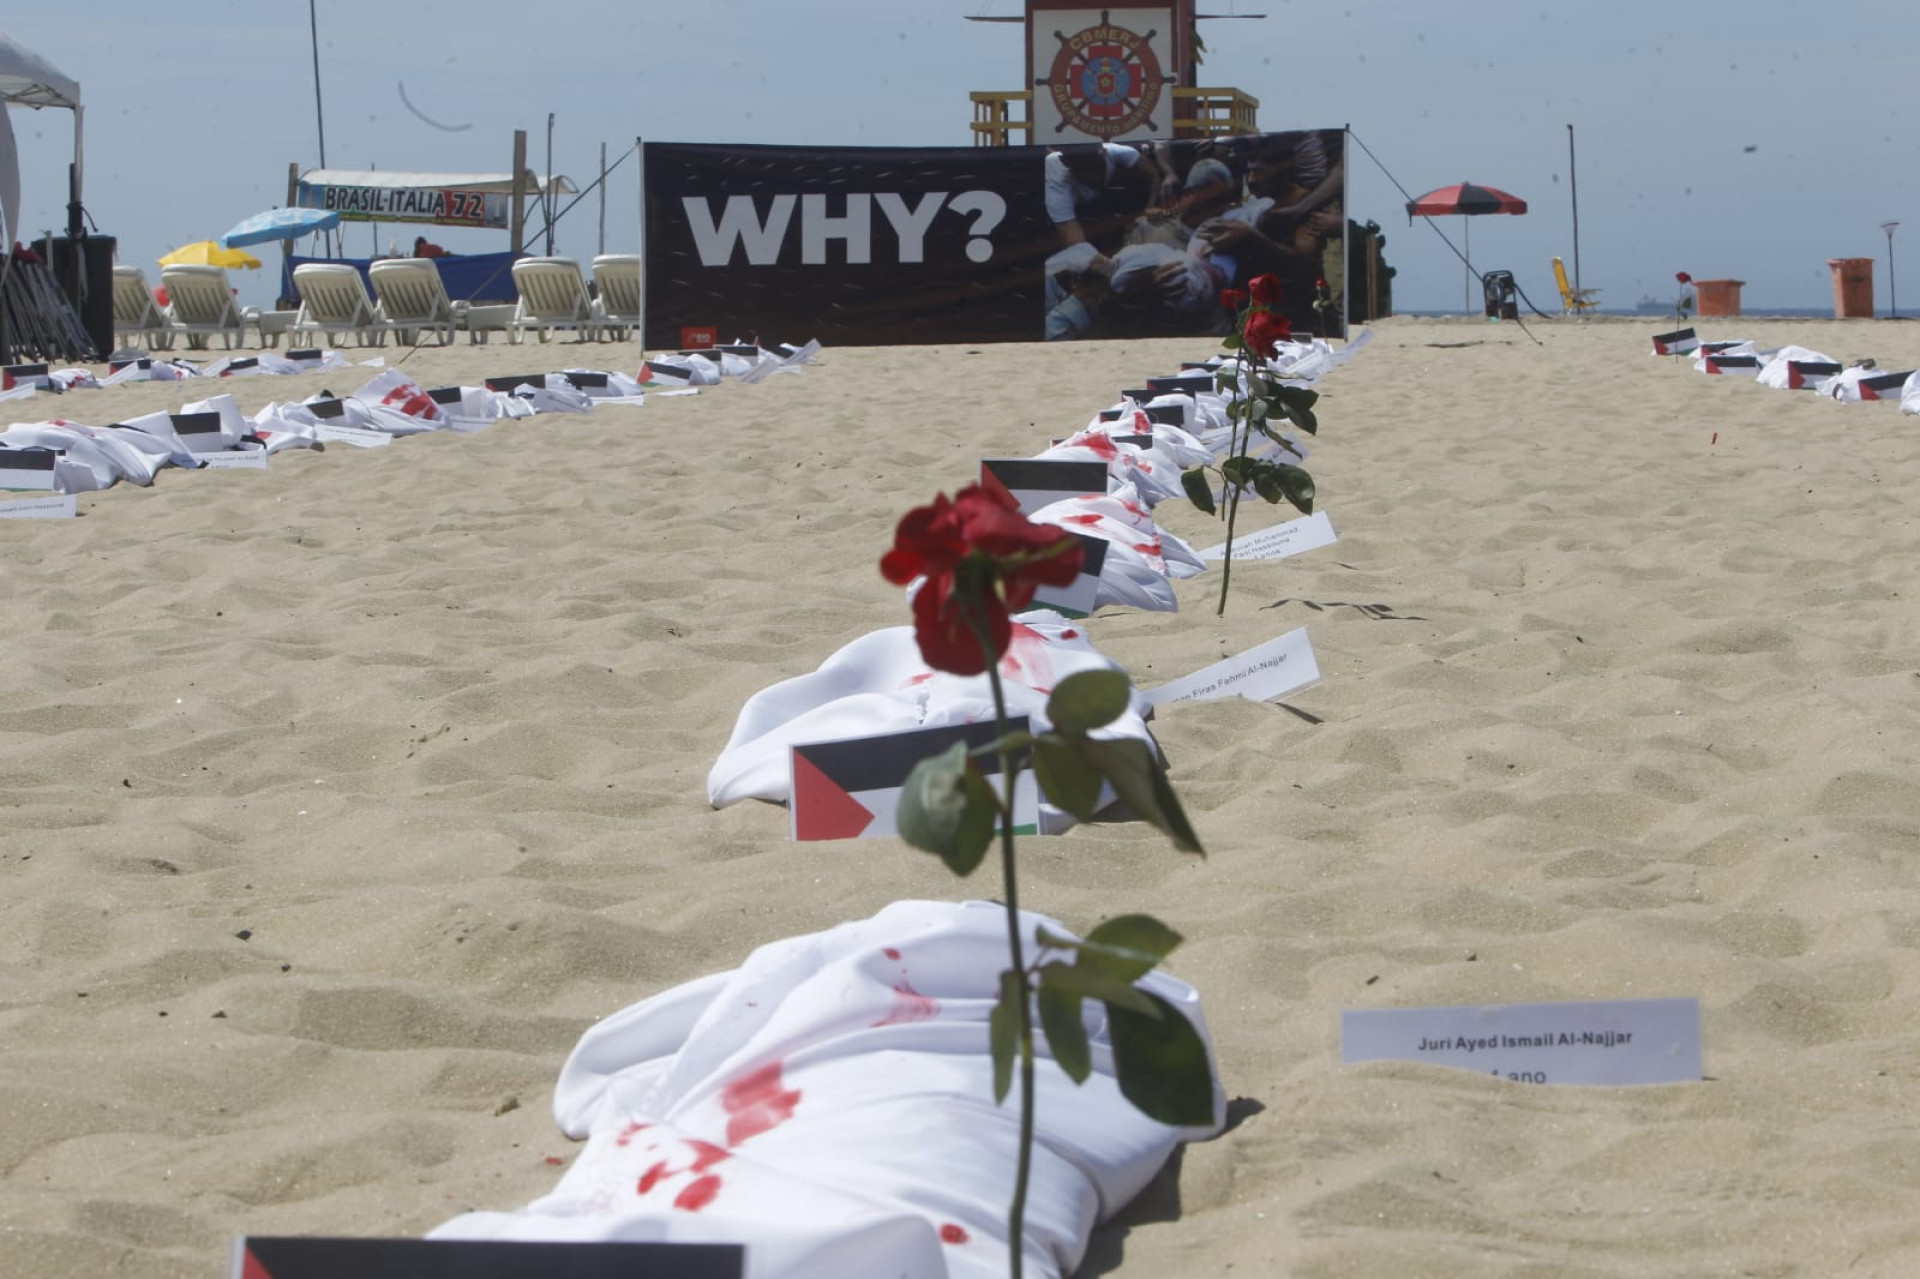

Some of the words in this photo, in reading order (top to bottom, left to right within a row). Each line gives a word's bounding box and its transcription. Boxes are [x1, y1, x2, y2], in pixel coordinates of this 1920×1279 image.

[1069, 30, 1140, 50] CBMERJ
[325, 187, 446, 214] BRASIL-ITALIA
[452, 193, 485, 218] 72
[683, 190, 1007, 266] WHY?
[1193, 684, 1216, 698] Firas
[1218, 672, 1247, 687] Fahmi
[1247, 653, 1287, 675] Al-Najjar
[1418, 1036, 1452, 1051] Juri
[1455, 1035, 1497, 1054] Ayed
[1501, 1033, 1553, 1049] Ismail
[1557, 1030, 1633, 1048] Al-Najjar
